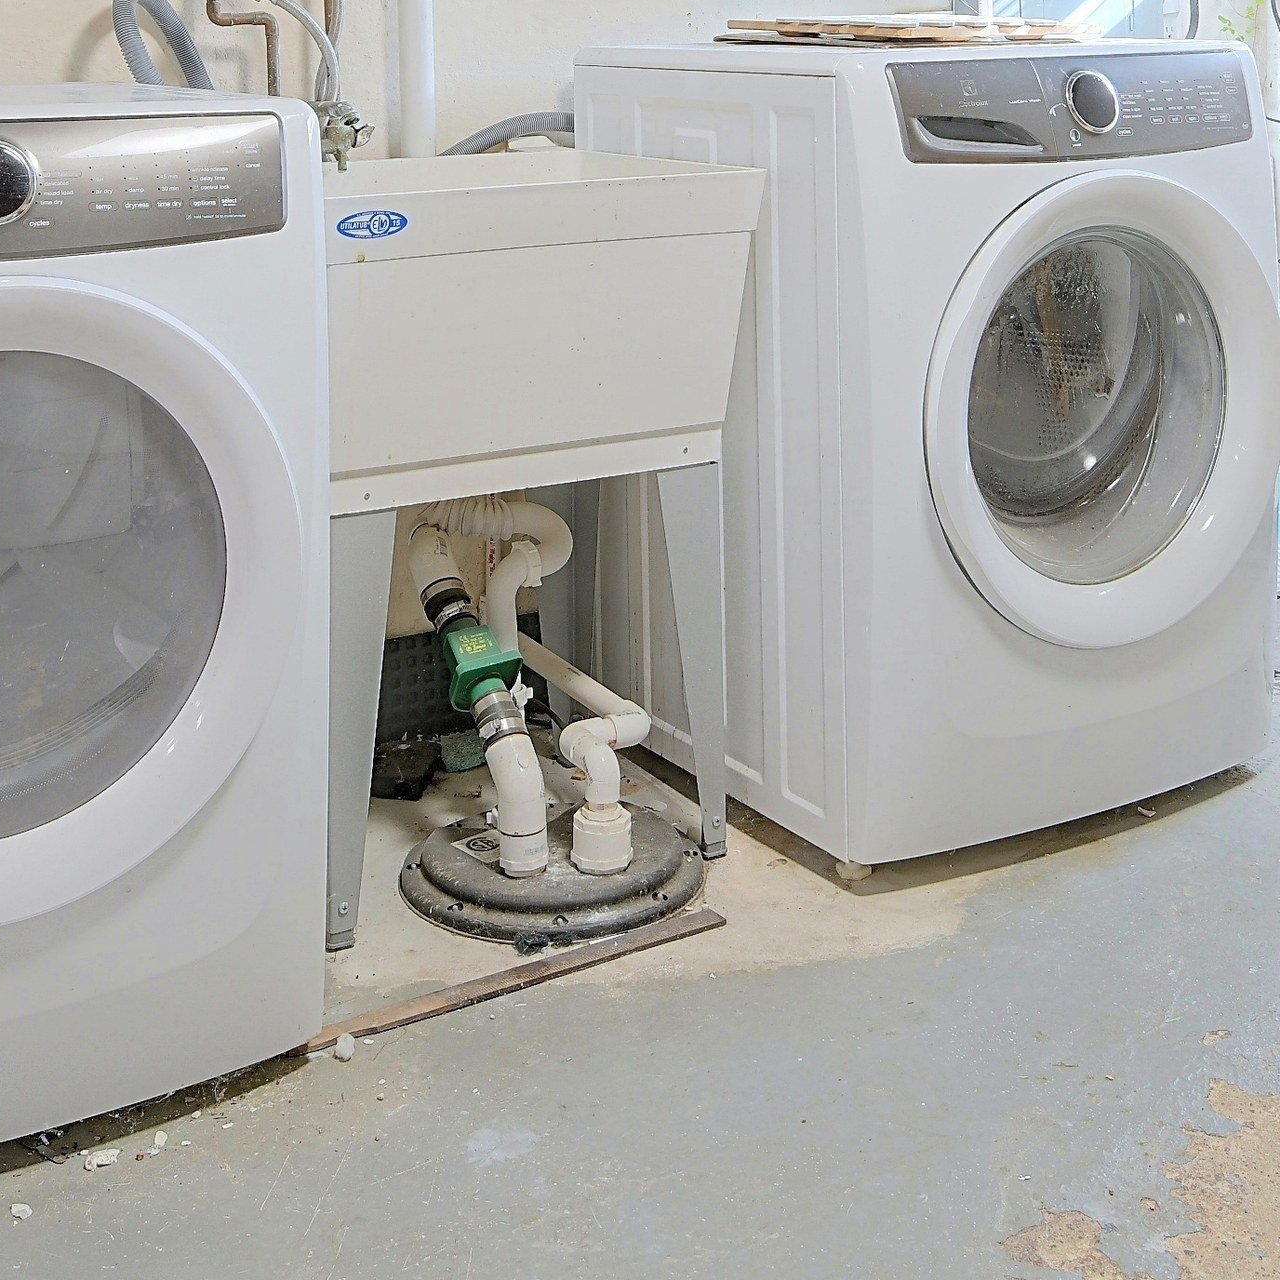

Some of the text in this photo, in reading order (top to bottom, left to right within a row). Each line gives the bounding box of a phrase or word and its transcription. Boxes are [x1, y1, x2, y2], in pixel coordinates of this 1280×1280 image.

[103, 188, 113, 196] dry
[53, 199, 63, 207] dry
[95, 202, 113, 211] temp
[124, 201, 150, 210] dryness
[171, 199, 183, 208] dry
[193, 199, 217, 208] options
[29, 219, 50, 228] cycles
